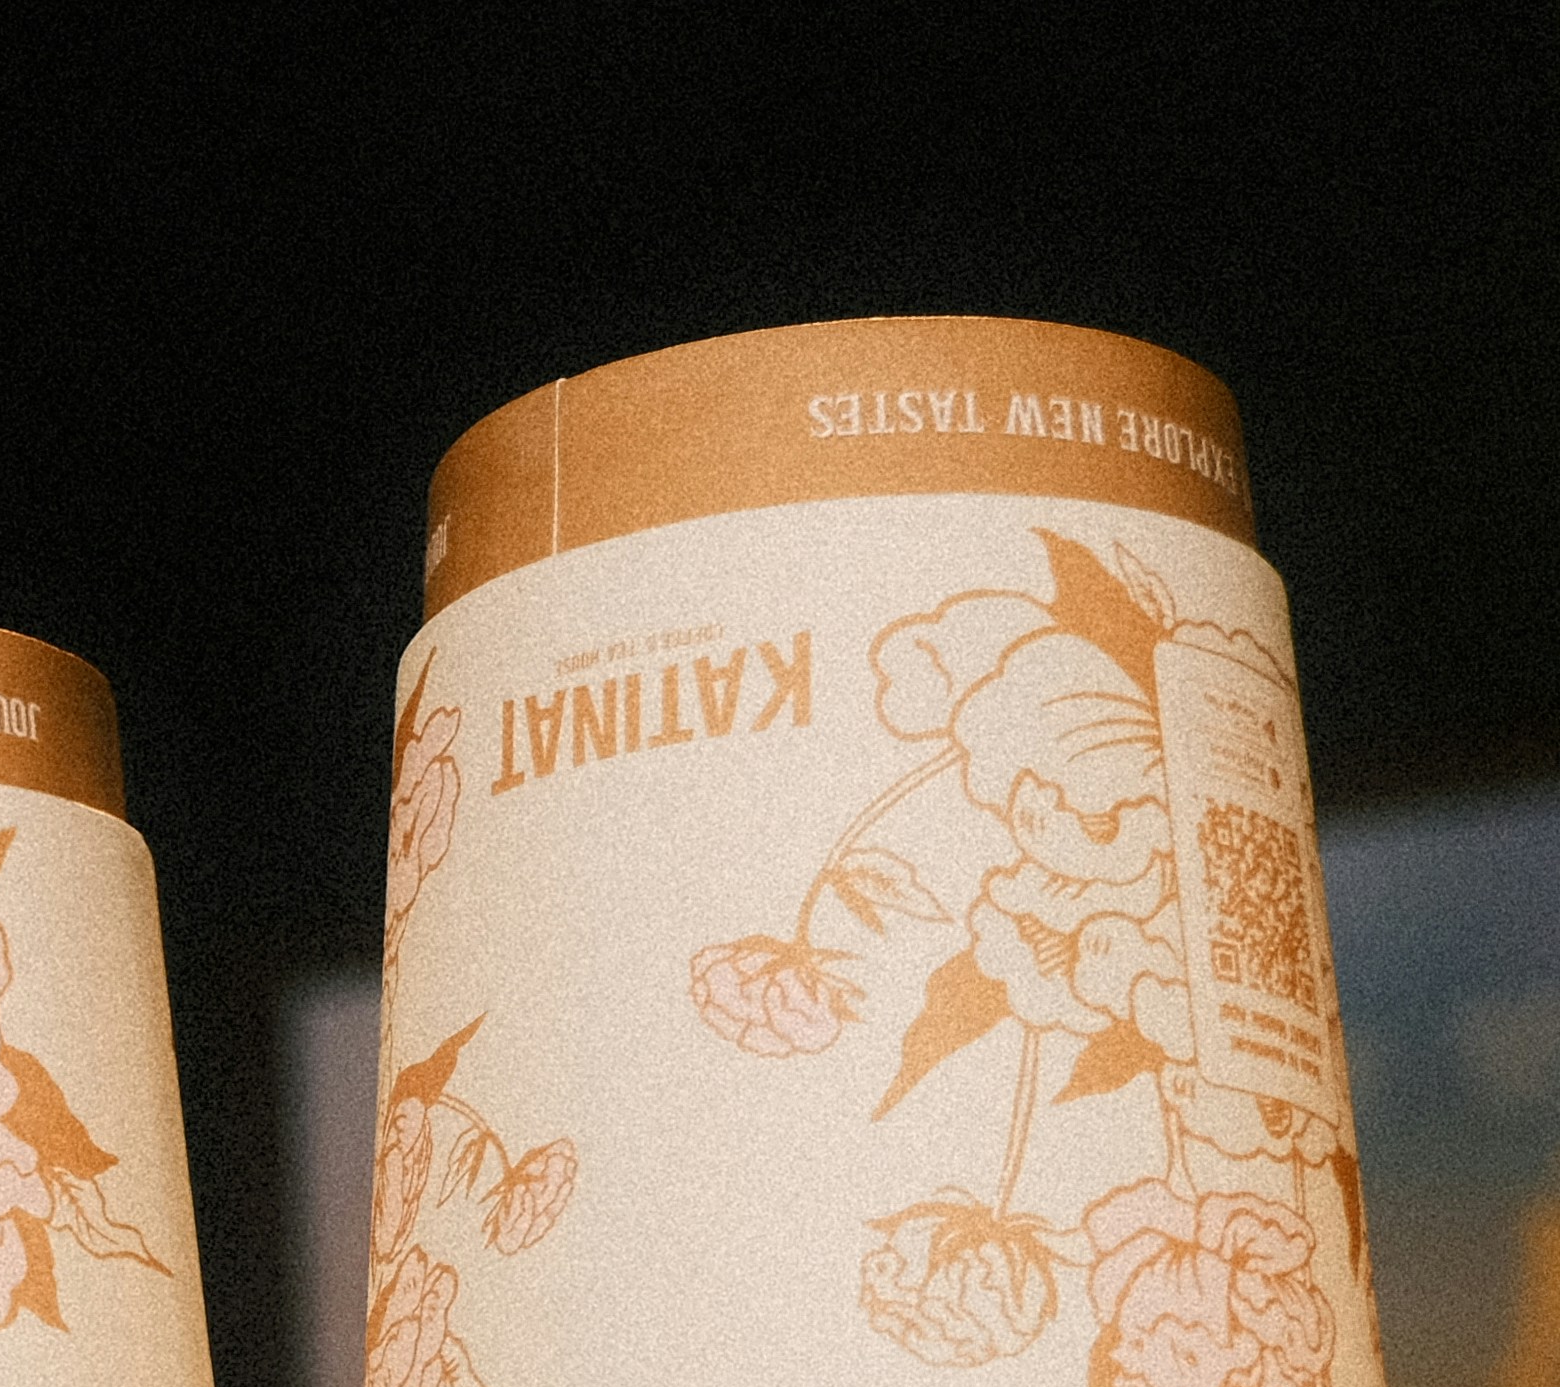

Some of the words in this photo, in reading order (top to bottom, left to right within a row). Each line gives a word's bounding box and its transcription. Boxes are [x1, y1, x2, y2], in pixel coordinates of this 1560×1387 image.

[808, 389, 985, 440] TASTES
[1006, 393, 1104, 444] NEW
[491, 629, 812, 795] KATINAT
